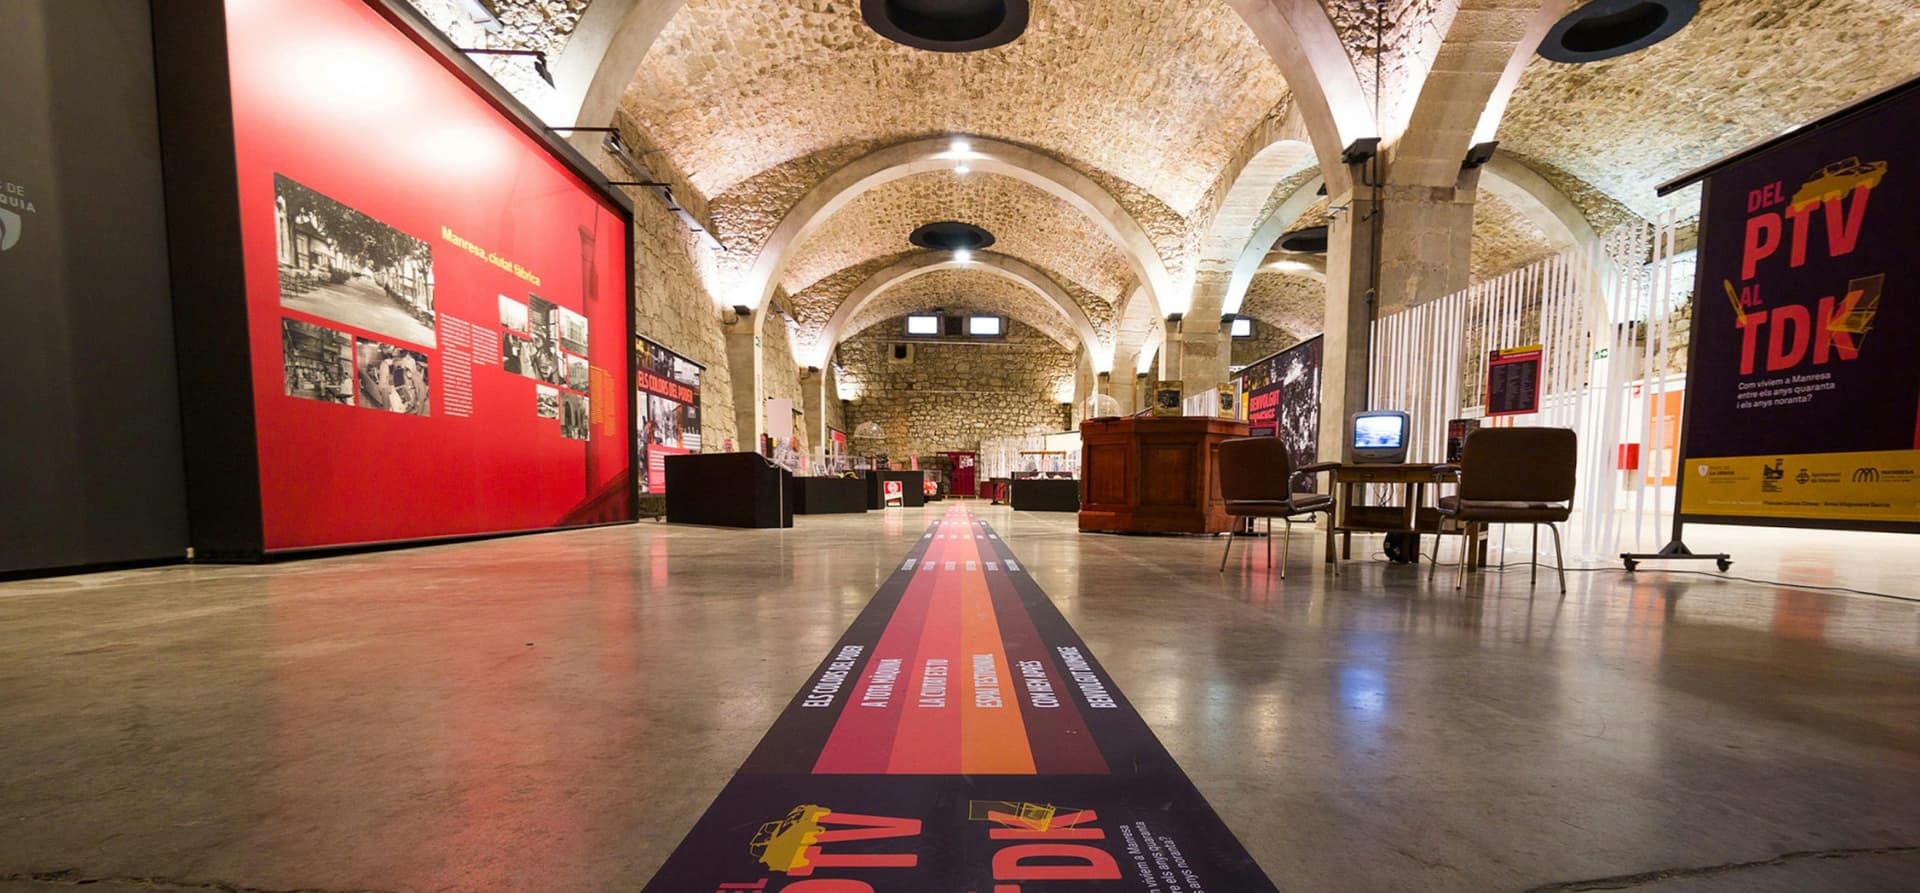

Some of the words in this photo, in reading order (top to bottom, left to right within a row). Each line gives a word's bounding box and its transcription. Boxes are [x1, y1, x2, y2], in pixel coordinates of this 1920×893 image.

[8, 182, 25, 197] DE
[1747, 181, 1785, 213] DEL
[1741, 181, 1872, 281] PTV
[442, 225, 488, 262] Manresa,
[488, 252, 513, 273] ciutat
[1740, 284, 1763, 307] AL
[1736, 289, 1865, 375] TDK
[637, 369, 649, 389] ELS
[1738, 382, 1756, 390] Com
[1792, 372, 1832, 383] Manresa
[1737, 391, 1758, 400] entre
[1759, 389, 1773, 398] els
[1773, 387, 1793, 397] anys
[1794, 382, 1836, 395] quaranta
[1740, 401, 1753, 409] els
[1753, 399, 1773, 409] anys
[1774, 393, 1813, 405] noranta?
[835, 645, 865, 661] PODER
[828, 661, 856, 671] DEL
[812, 671, 849, 694] COLORS
[863, 684, 895, 700] TOTA
[920, 676, 947, 697] CIUTAT
[1025, 678, 1053, 692] HEM
[1070, 671, 1118, 708] BENVOLGUT
[802, 694, 835, 707] ELS
[918, 698, 946, 707] LA
[1029, 692, 1060, 708] COM
[1120, 825, 1142, 854] Manresa
[1136, 821, 1161, 851] quaranta
[1152, 852, 1170, 870] anys
[1158, 836, 1189, 868] noranta?
[1161, 871, 1177, 883] els
[1181, 869, 1200, 889] anys
